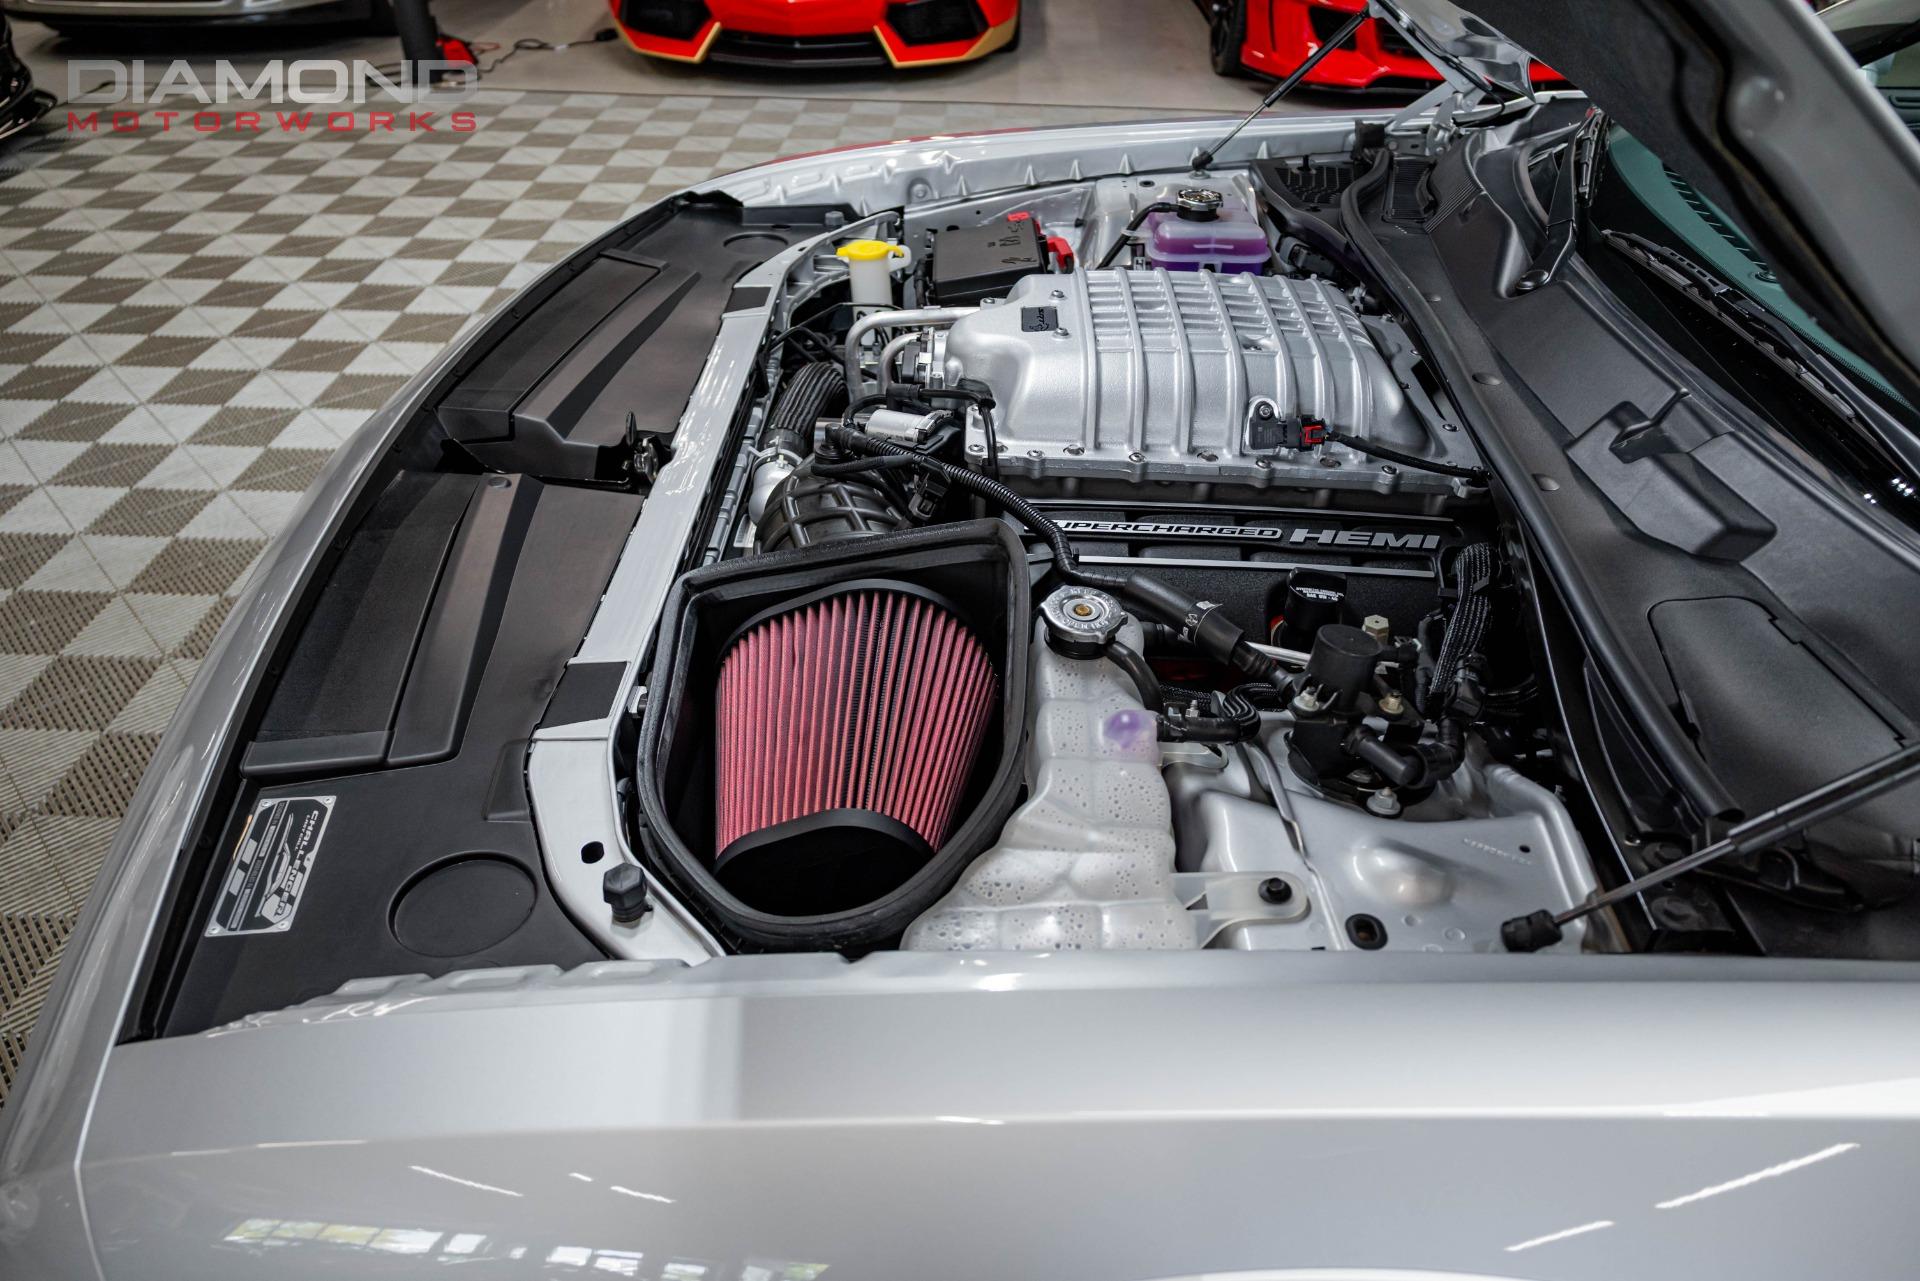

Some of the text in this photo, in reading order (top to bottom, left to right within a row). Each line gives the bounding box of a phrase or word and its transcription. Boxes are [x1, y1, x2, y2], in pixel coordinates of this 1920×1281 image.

[1063, 522, 1440, 549] PERCHARGED HEMI
[274, 810, 319, 917] CHALLENGER
